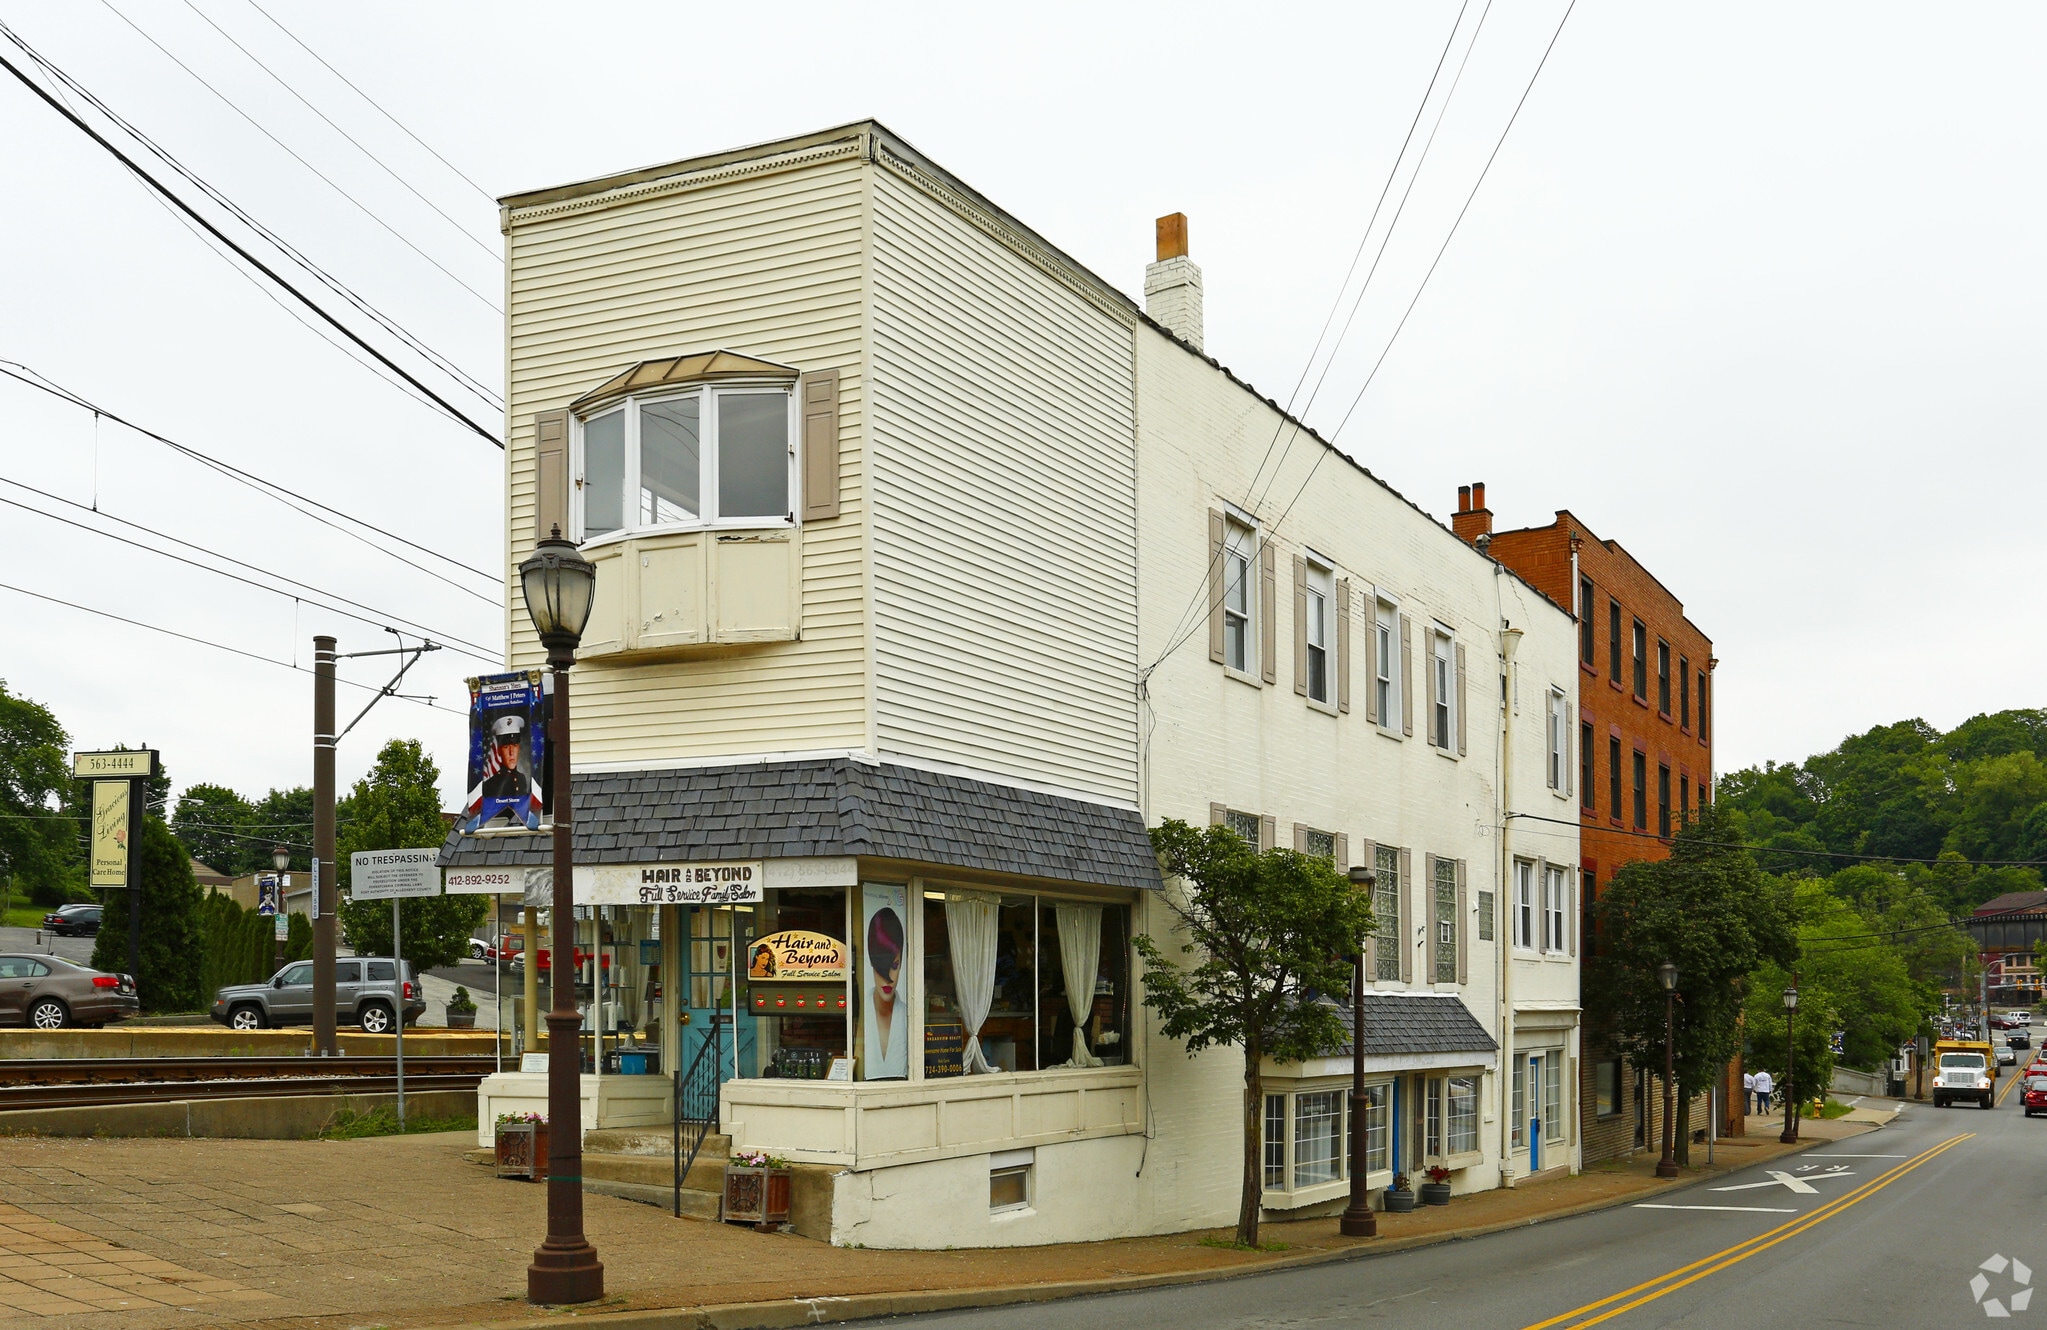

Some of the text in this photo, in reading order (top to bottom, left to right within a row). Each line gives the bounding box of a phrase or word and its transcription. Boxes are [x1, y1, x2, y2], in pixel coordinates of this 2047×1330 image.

[90, 758, 134, 770] 563-4444
[96, 790, 128, 824] Gracious
[97, 812, 126, 842] Living
[96, 858, 122, 866] Personal
[355, 854, 436, 866] NO TRESPASSING
[448, 874, 510, 885] 412-892-9252
[641, 868, 681, 883] HAIR
[694, 866, 752, 882] BEYOND
[639, 884, 757, 903] Full Service Family Salon
[771, 934, 831, 949] Hair and
[781, 949, 839, 968] Beyond
[781, 970, 841, 978] Full Service Salon
